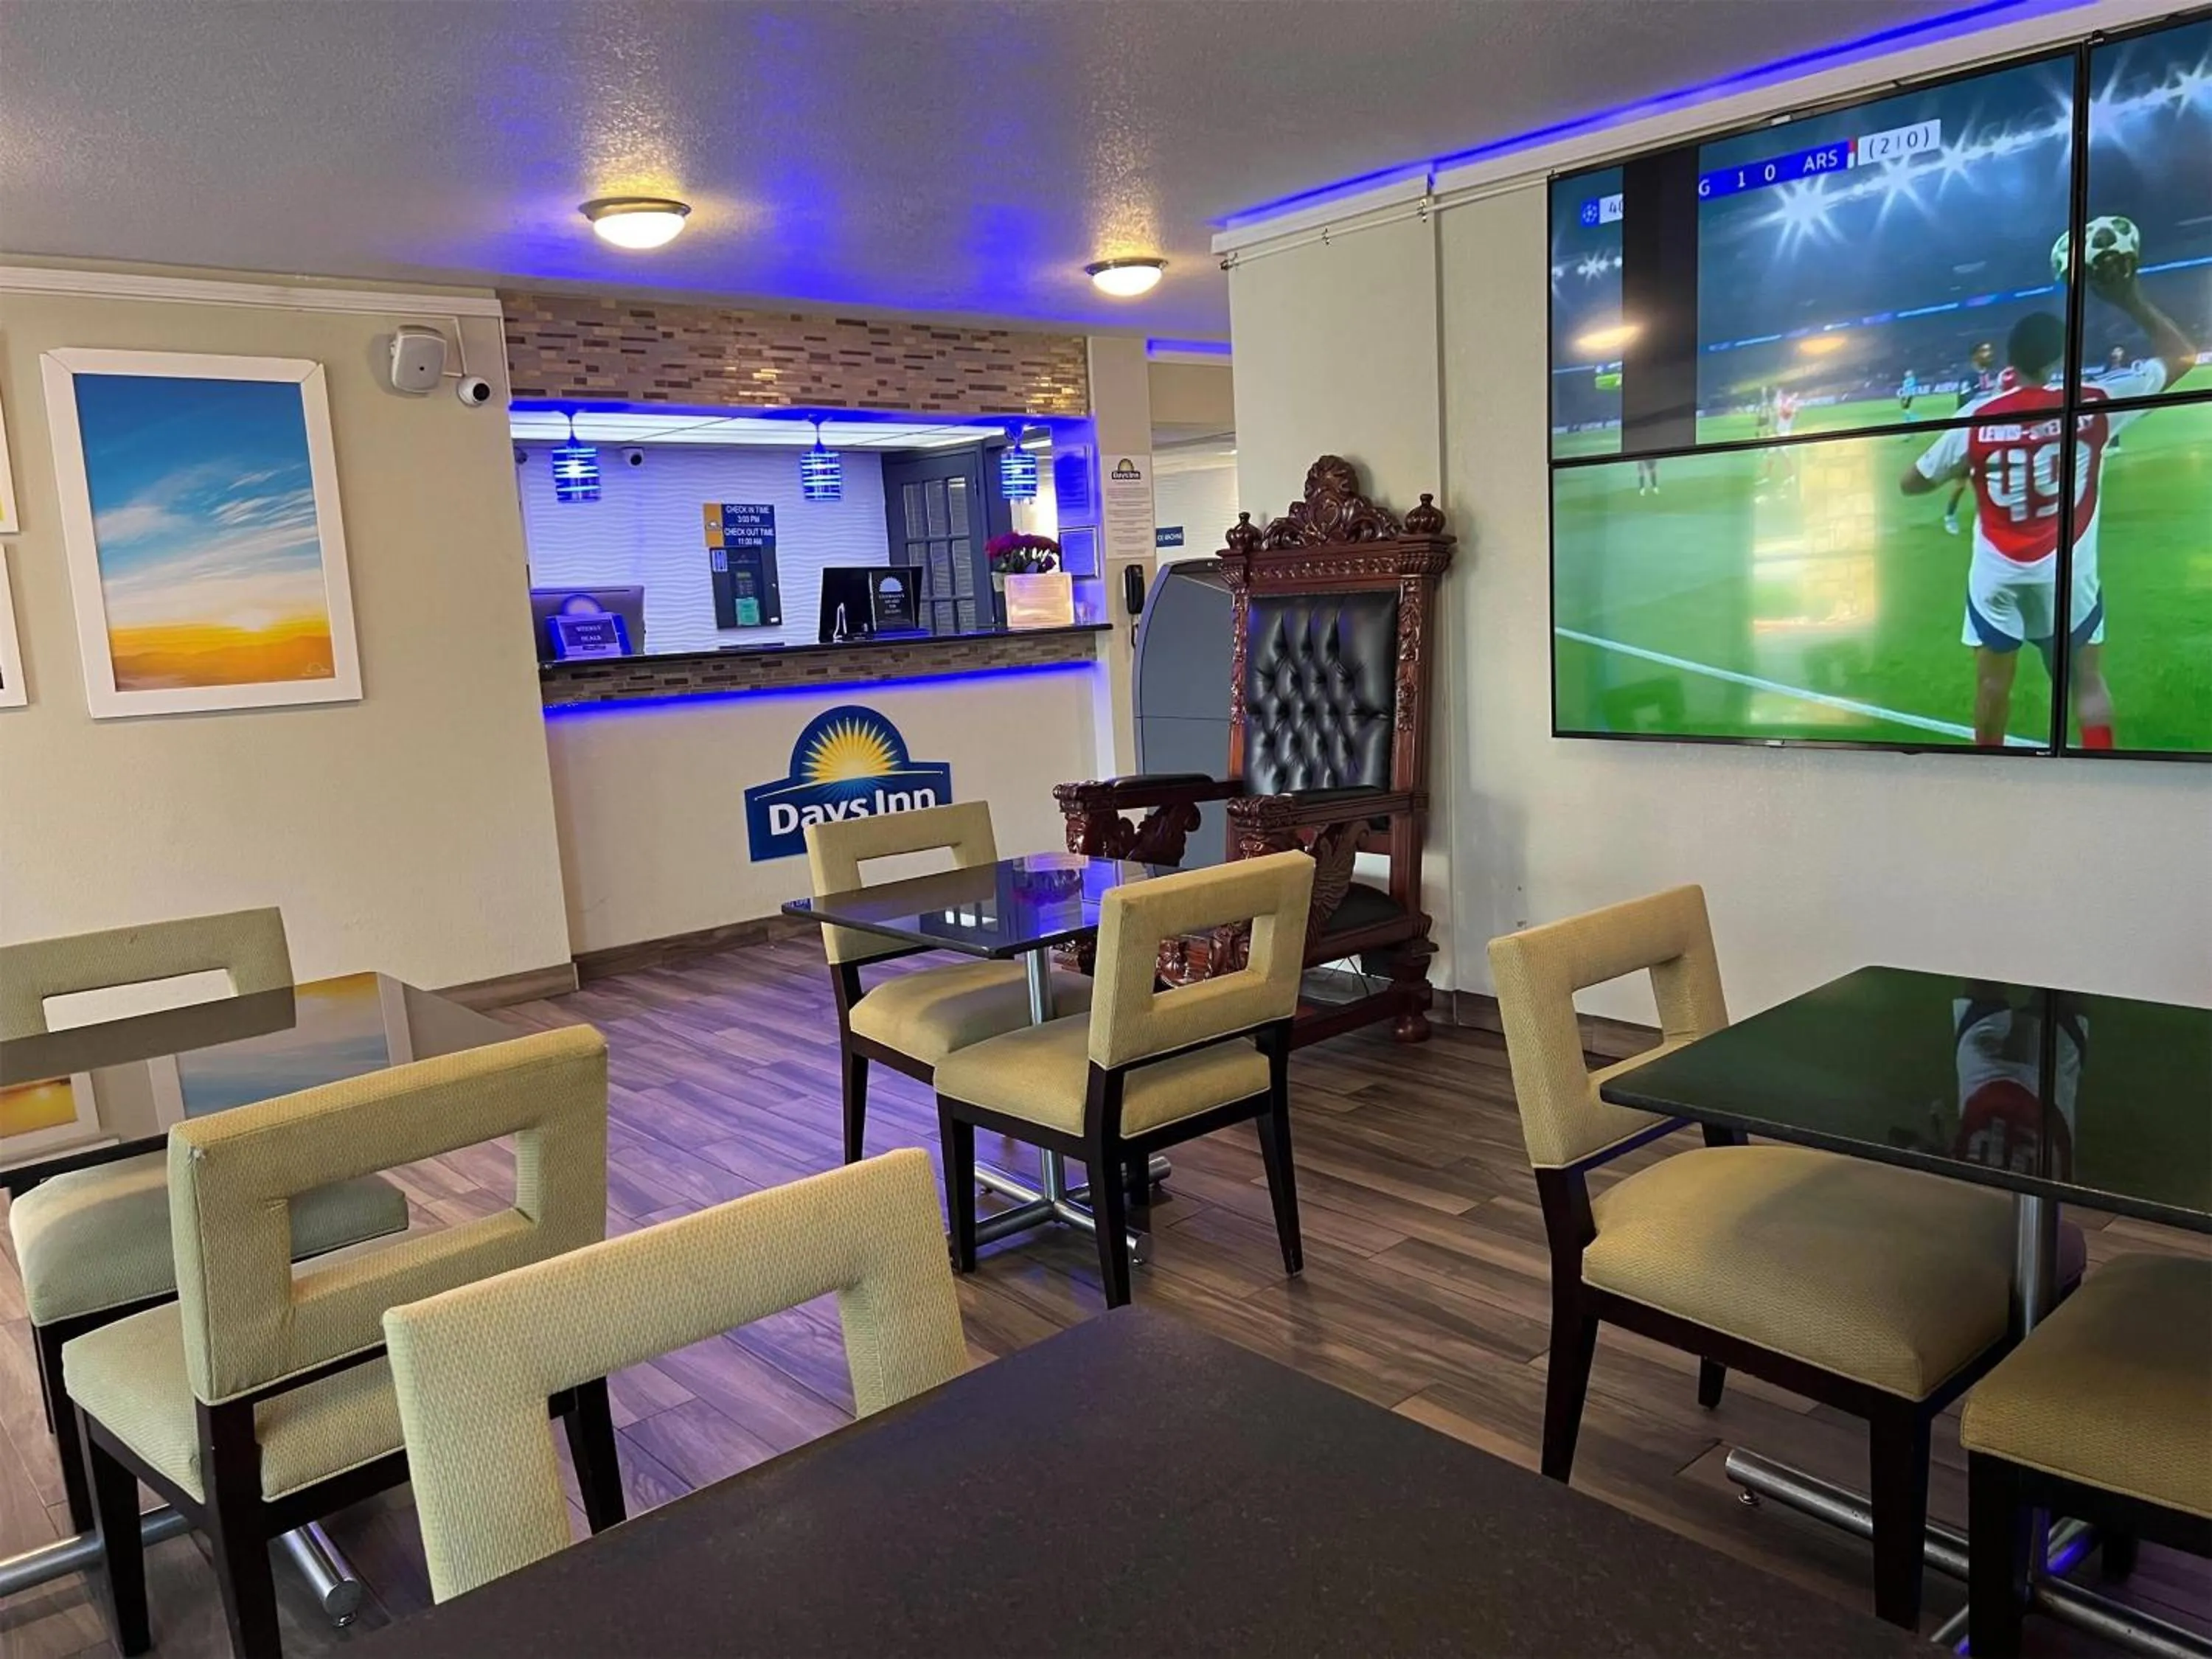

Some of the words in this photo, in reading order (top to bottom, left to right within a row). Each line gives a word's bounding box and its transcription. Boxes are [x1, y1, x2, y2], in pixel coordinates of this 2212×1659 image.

[1738, 171, 1746, 187] 1
[1764, 164, 1775, 181] 0
[1802, 149, 1838, 173] ARS
[1986, 441, 2090, 522] 49
[725, 505, 746, 514] CHECK
[756, 505, 771, 514] TIME
[737, 515, 750, 524] 3:00
[750, 515, 760, 524] PM
[724, 527, 746, 536] CHECK
[747, 527, 759, 536] OUT
[760, 527, 774, 536] TIME
[738, 538, 752, 546] 11:00
[753, 538, 763, 546] AM
[769, 796, 869, 835] Days
[875, 787, 936, 815] Inn
